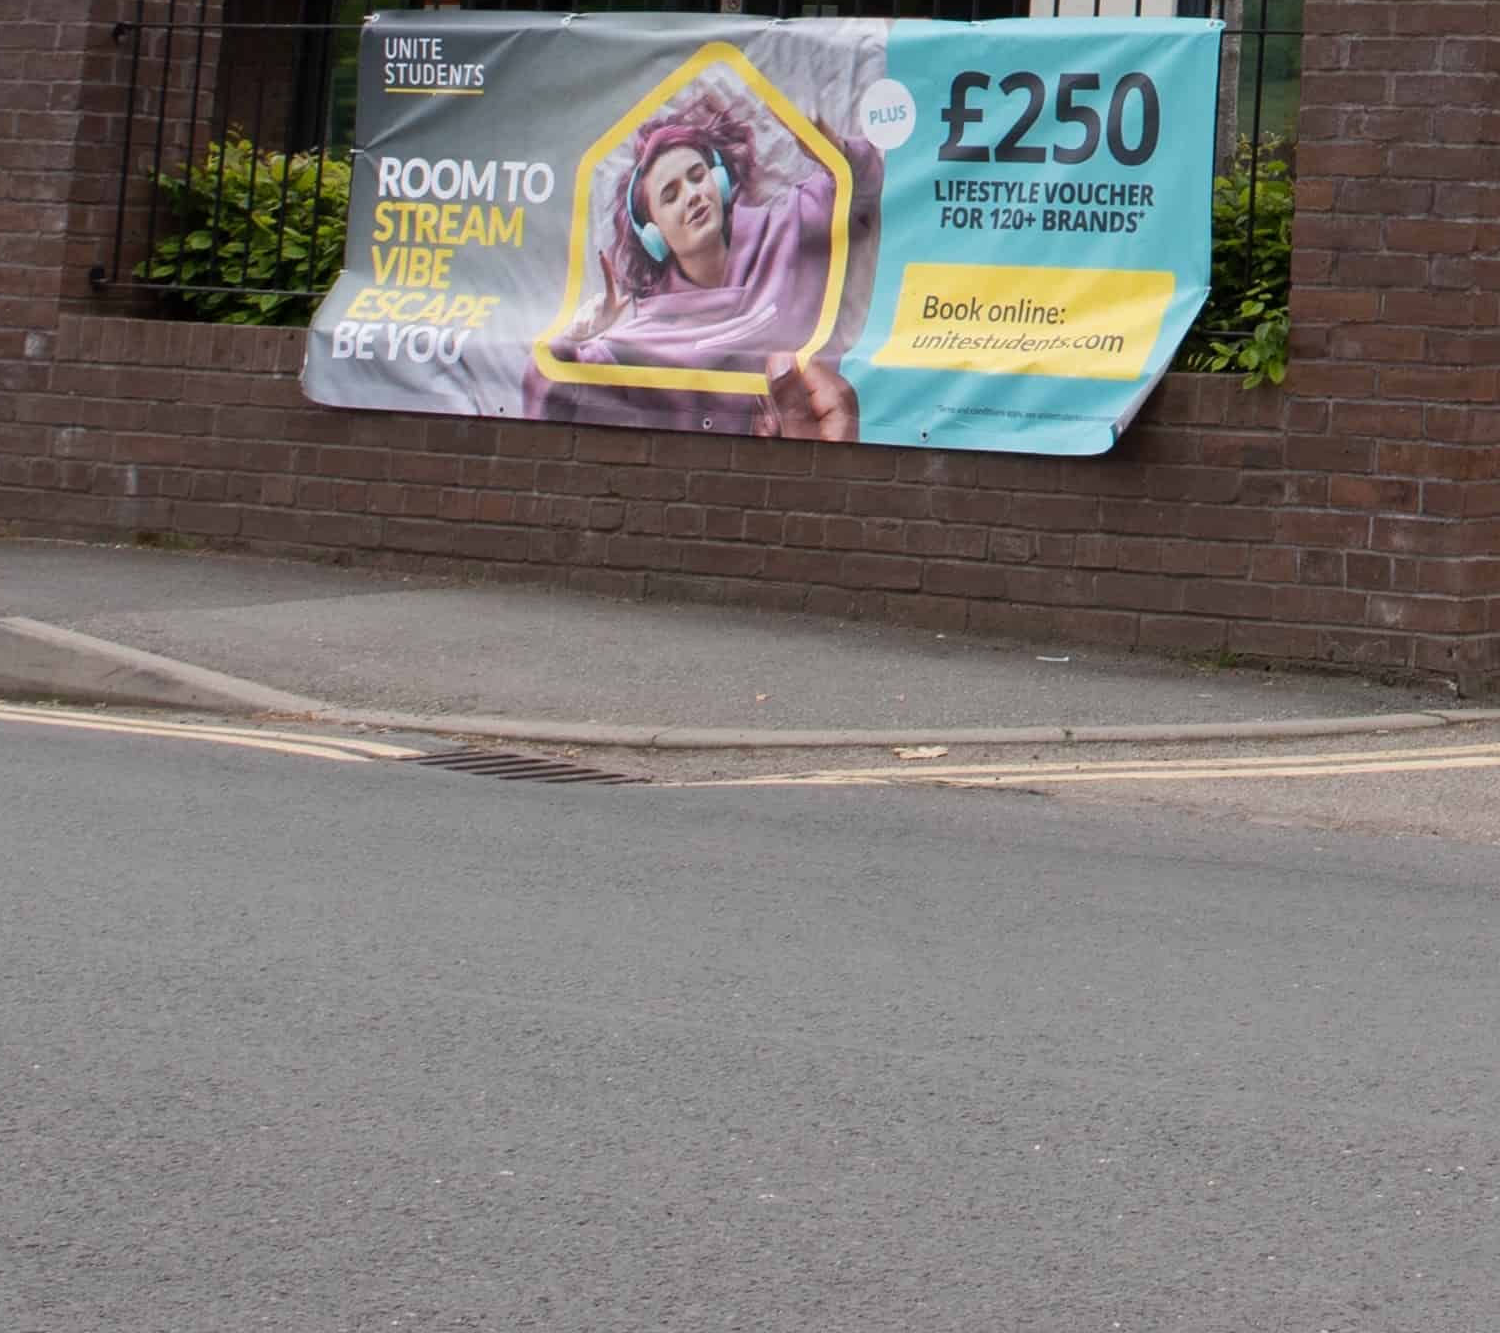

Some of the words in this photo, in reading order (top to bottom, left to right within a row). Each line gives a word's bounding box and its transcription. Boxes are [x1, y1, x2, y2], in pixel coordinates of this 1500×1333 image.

[384, 37, 442, 60] UNITE
[384, 62, 485, 86] STUDENTS
[869, 104, 907, 125] PLUS
[937, 70, 1160, 166] £250
[378, 156, 497, 202] ROOM
[501, 161, 555, 204] TO
[934, 179, 1039, 204] LIFESTYLE
[1043, 182, 1154, 206] VOUCHER
[372, 201, 525, 247] STREAM
[940, 206, 983, 229] FOR
[990, 208, 1036, 230] 120+
[371, 245, 453, 289] VIBE
[345, 288, 501, 327] ESCAPE
[922, 295, 984, 321] Book
[988, 298, 1066, 325] online:
[332, 320, 384, 360] BE
[386, 323, 472, 364] YOU
[911, 330, 1125, 353] unitestudents.com
